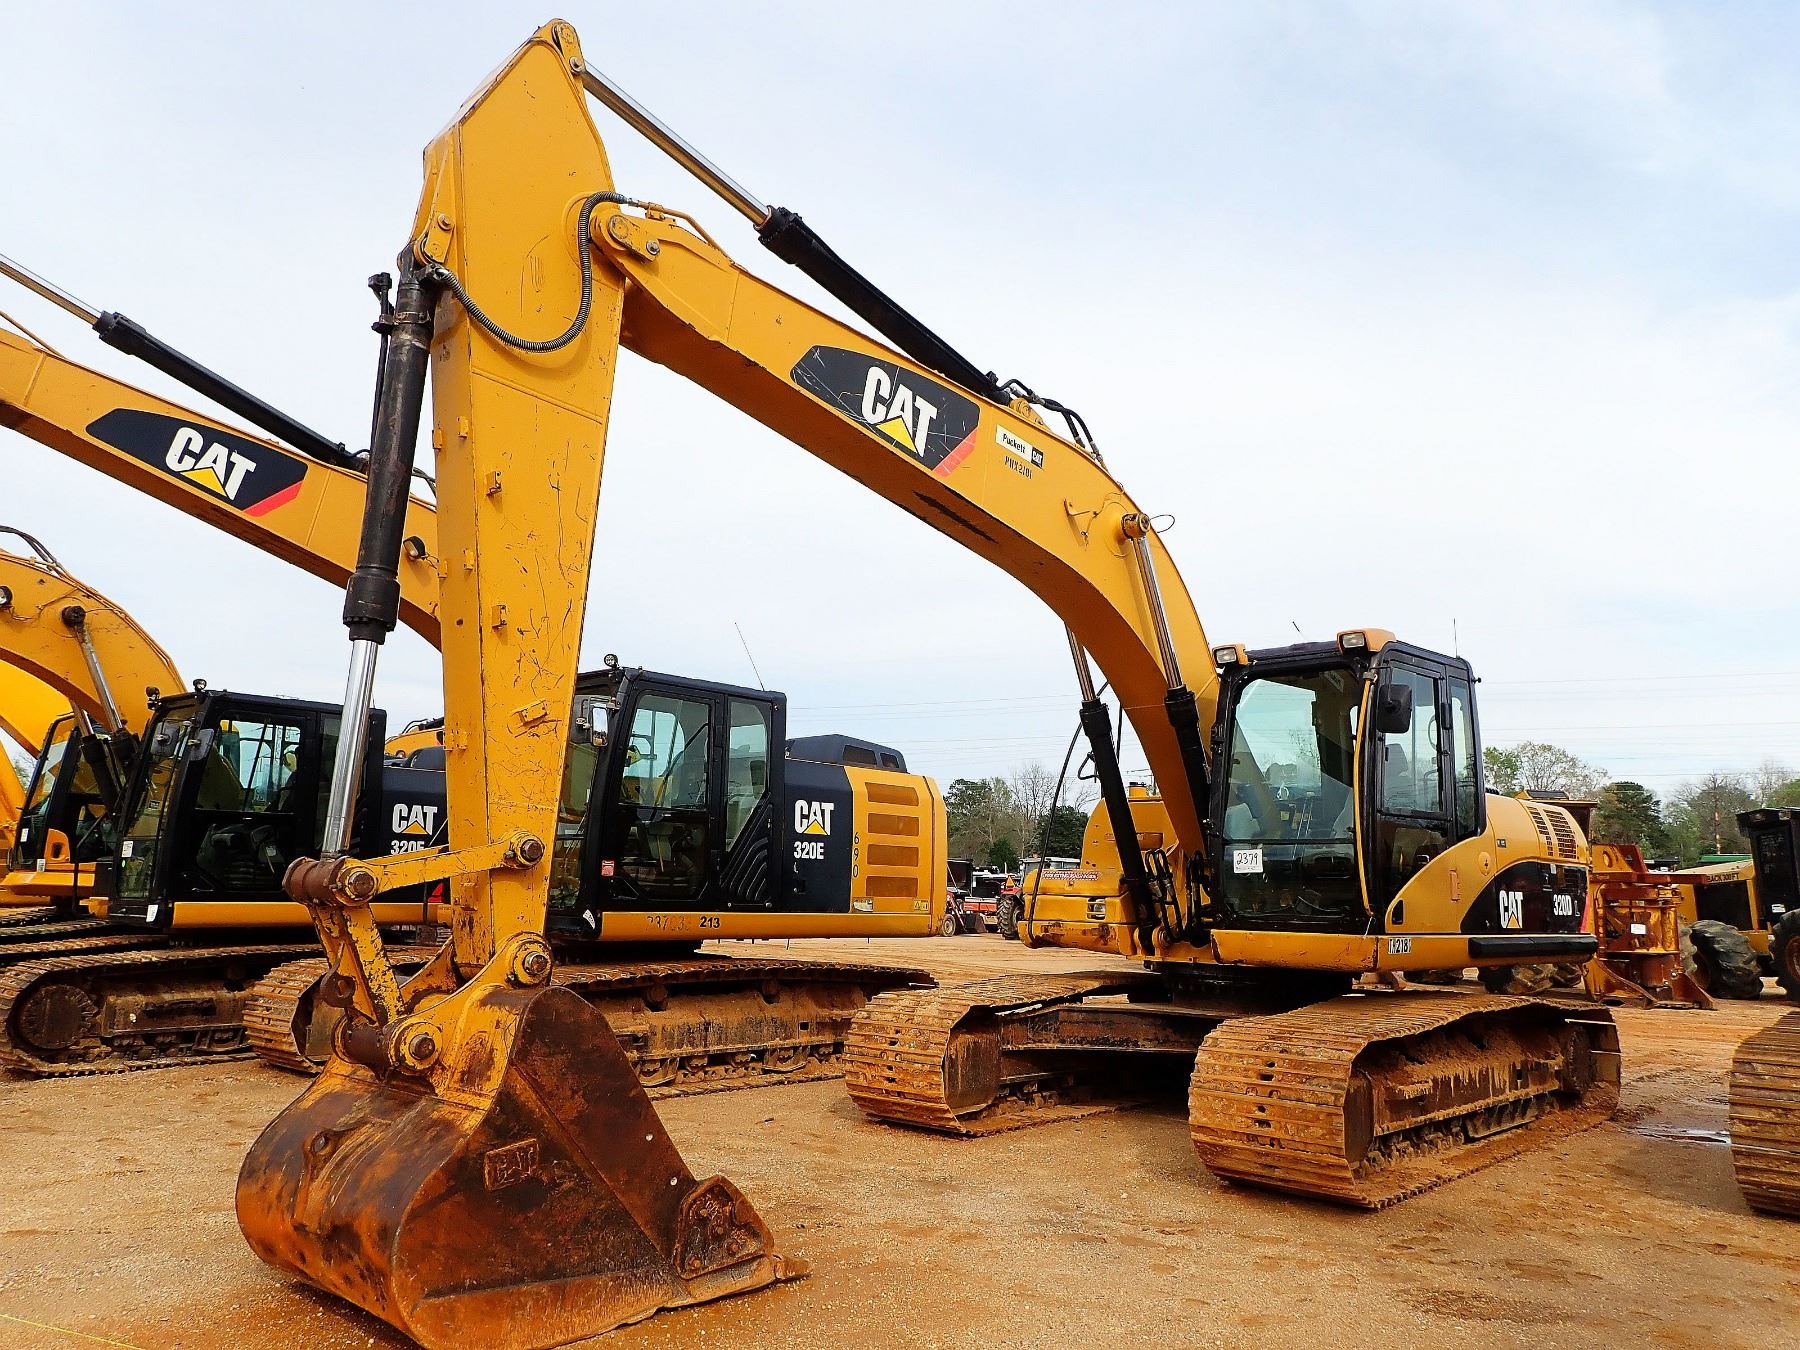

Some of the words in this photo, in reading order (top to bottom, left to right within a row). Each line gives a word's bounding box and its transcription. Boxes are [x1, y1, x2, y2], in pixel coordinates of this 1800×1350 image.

[862, 366, 938, 458] CAT
[165, 426, 257, 501] CAT
[392, 803, 438, 836] CAT
[794, 799, 835, 836] CAT
[793, 840, 825, 860] 320E
[1236, 852, 1259, 866] 2379
[1499, 889, 1524, 929] CAT
[1553, 893, 1572, 916] 320D
[699, 915, 721, 929] 213
